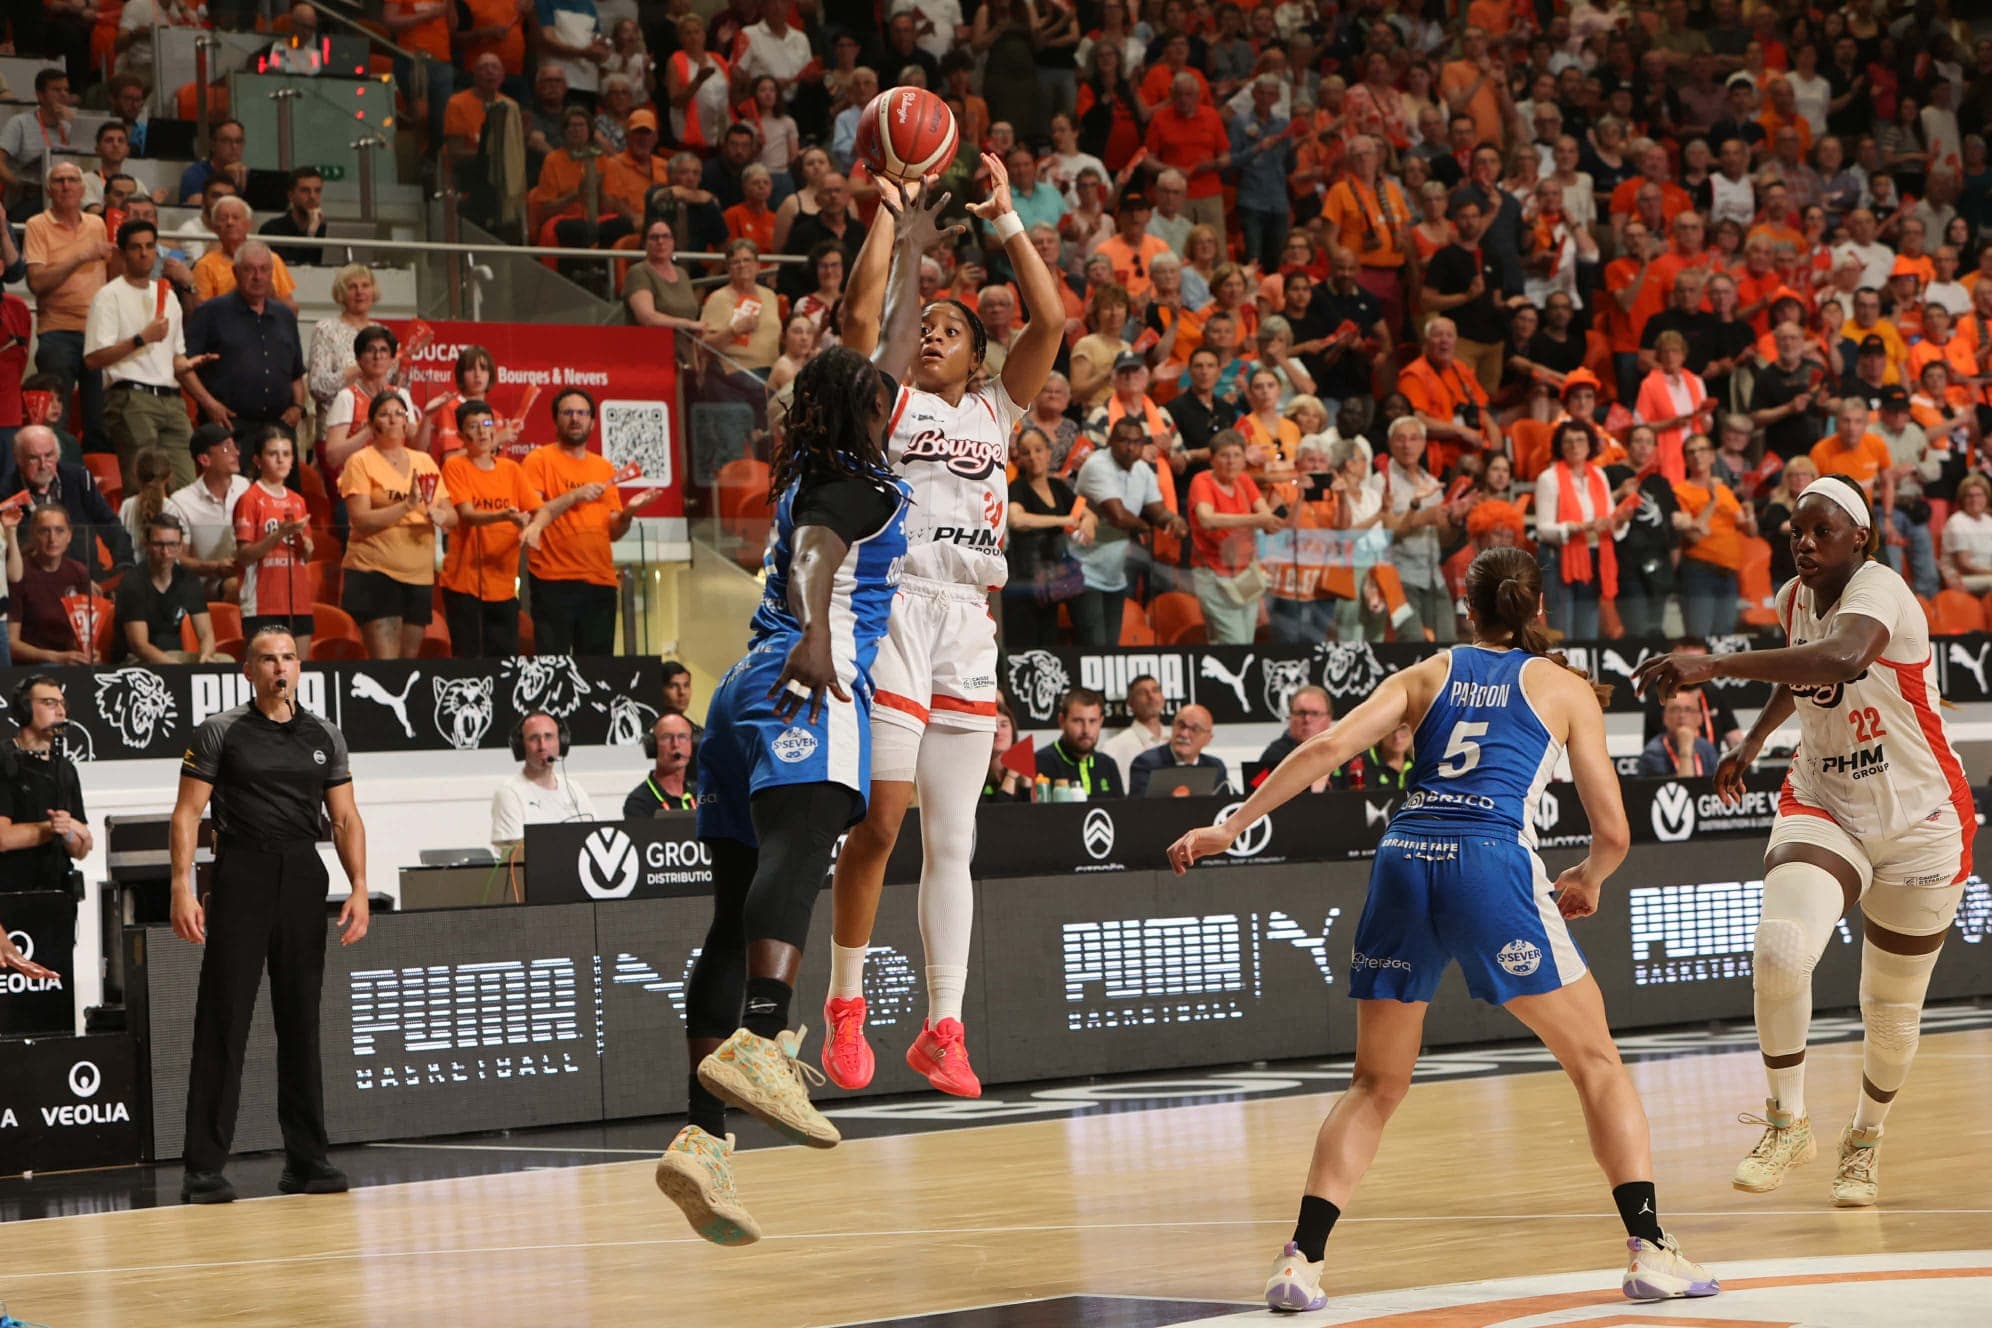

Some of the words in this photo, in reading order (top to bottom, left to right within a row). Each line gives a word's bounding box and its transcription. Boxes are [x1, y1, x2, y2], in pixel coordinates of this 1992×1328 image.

[497, 365, 551, 386] Bourges
[552, 366, 562, 385] &
[563, 367, 609, 386] Nevers
[191, 671, 328, 727] PUA
[1450, 681, 1511, 708] PARDON
[1848, 706, 1888, 743] 22
[1437, 720, 1490, 779] 5
[1822, 743, 1884, 773] PHM
[1852, 762, 1889, 780] GROUP
[646, 840, 713, 868] GROU
[646, 870, 713, 885] DISTRIBUTIO
[1062, 914, 1241, 1001] PUMA
[1507, 949, 1540, 962] SEVER
[0, 972, 63, 993] EOLIA
[350, 957, 577, 1055] PUMA
[41, 1102, 130, 1127] VEOLIA
